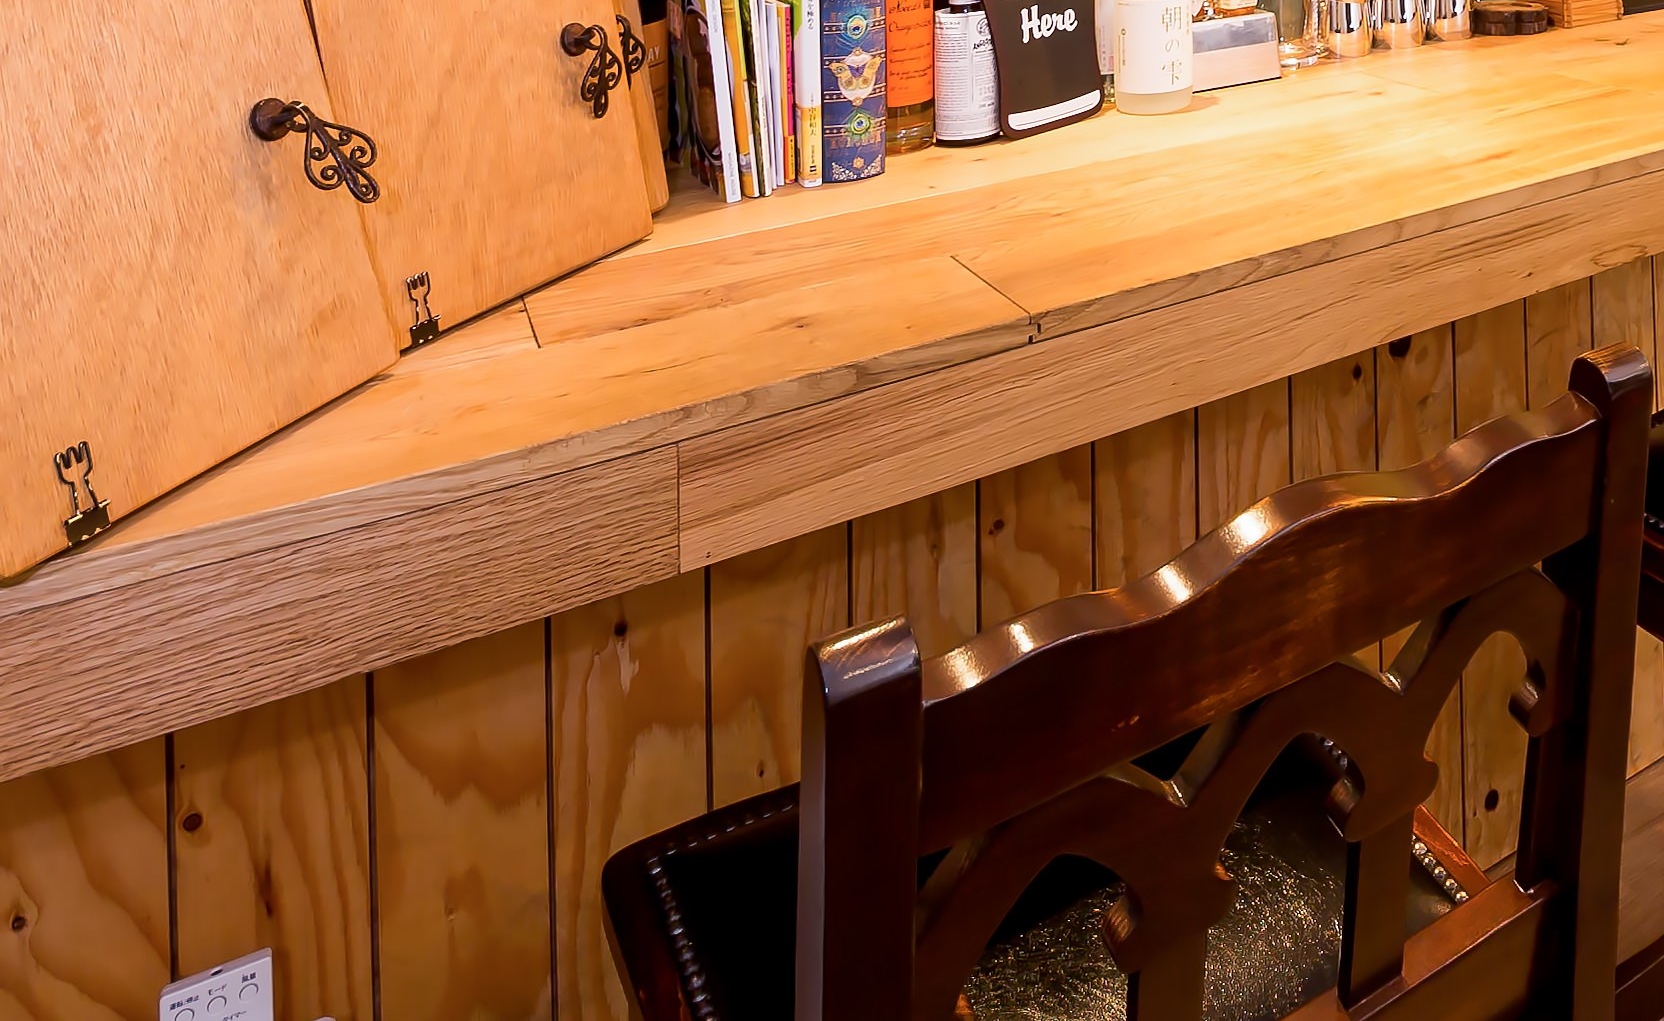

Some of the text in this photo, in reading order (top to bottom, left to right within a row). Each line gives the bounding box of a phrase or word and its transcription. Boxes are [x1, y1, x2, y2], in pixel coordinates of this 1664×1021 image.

[1020, 4, 1078, 44] Here
[1161, 6, 1183, 86] 朝の雫
